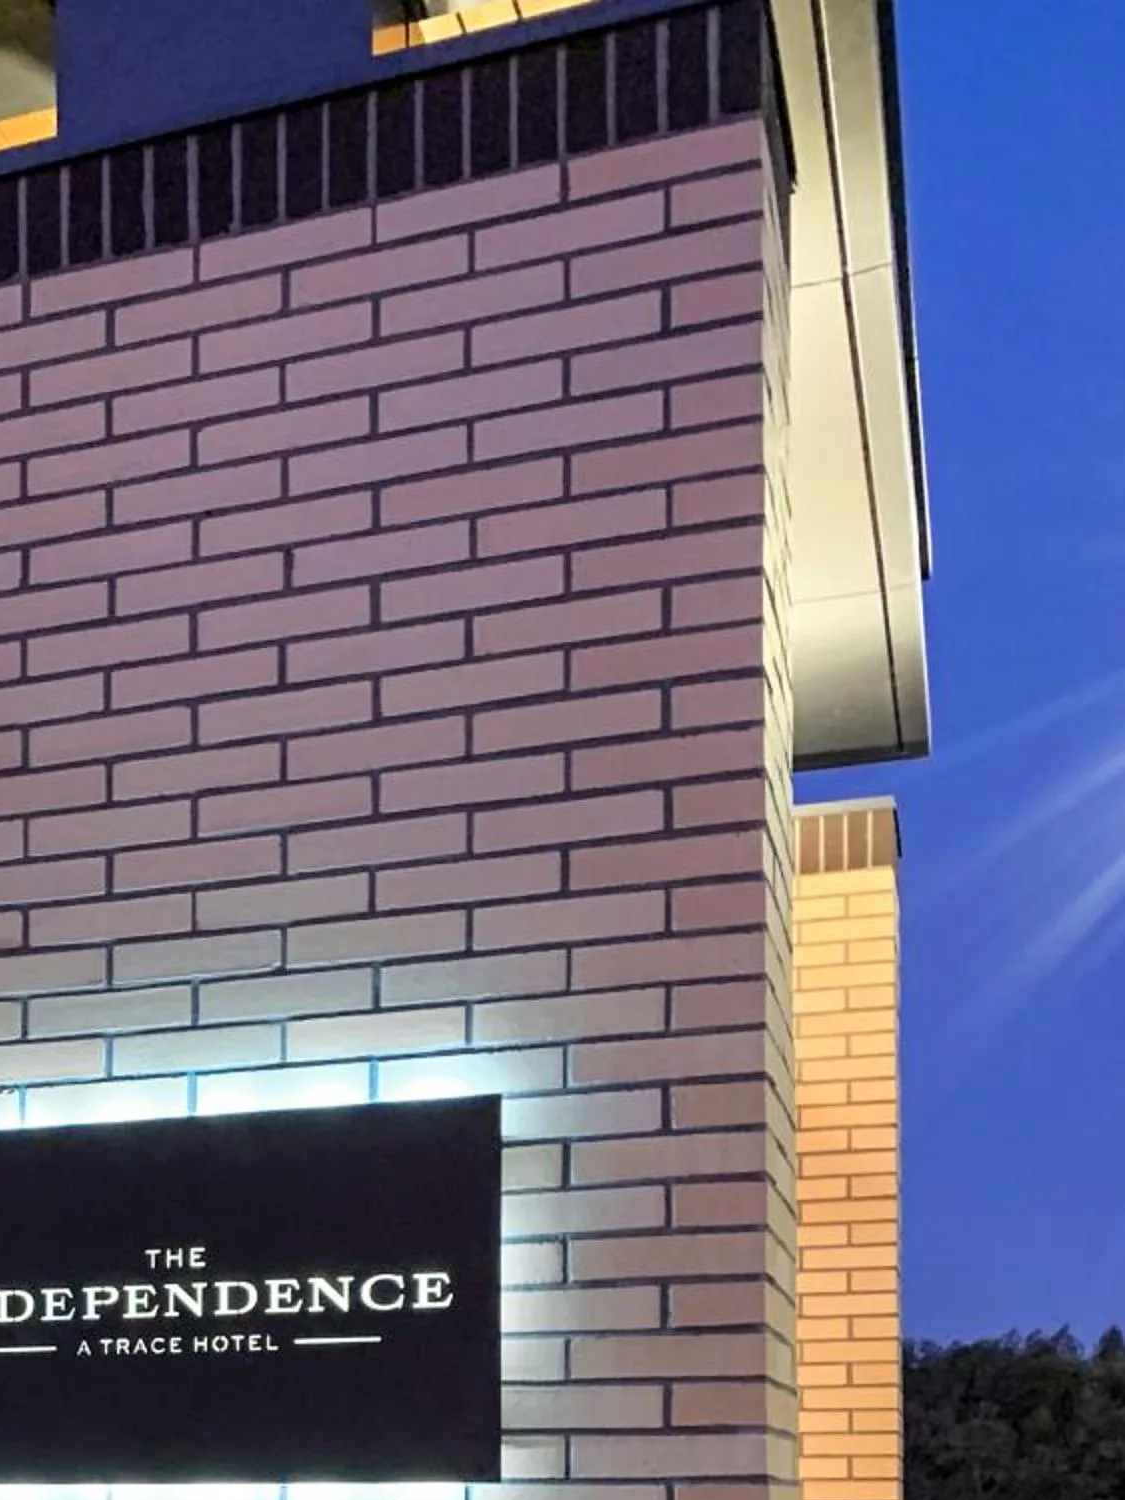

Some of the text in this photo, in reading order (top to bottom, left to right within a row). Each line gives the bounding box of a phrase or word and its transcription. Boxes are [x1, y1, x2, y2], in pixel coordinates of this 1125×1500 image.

[143, 1246, 207, 1270] THE
[76, 1333, 279, 1356] A TRACE HOTEL
